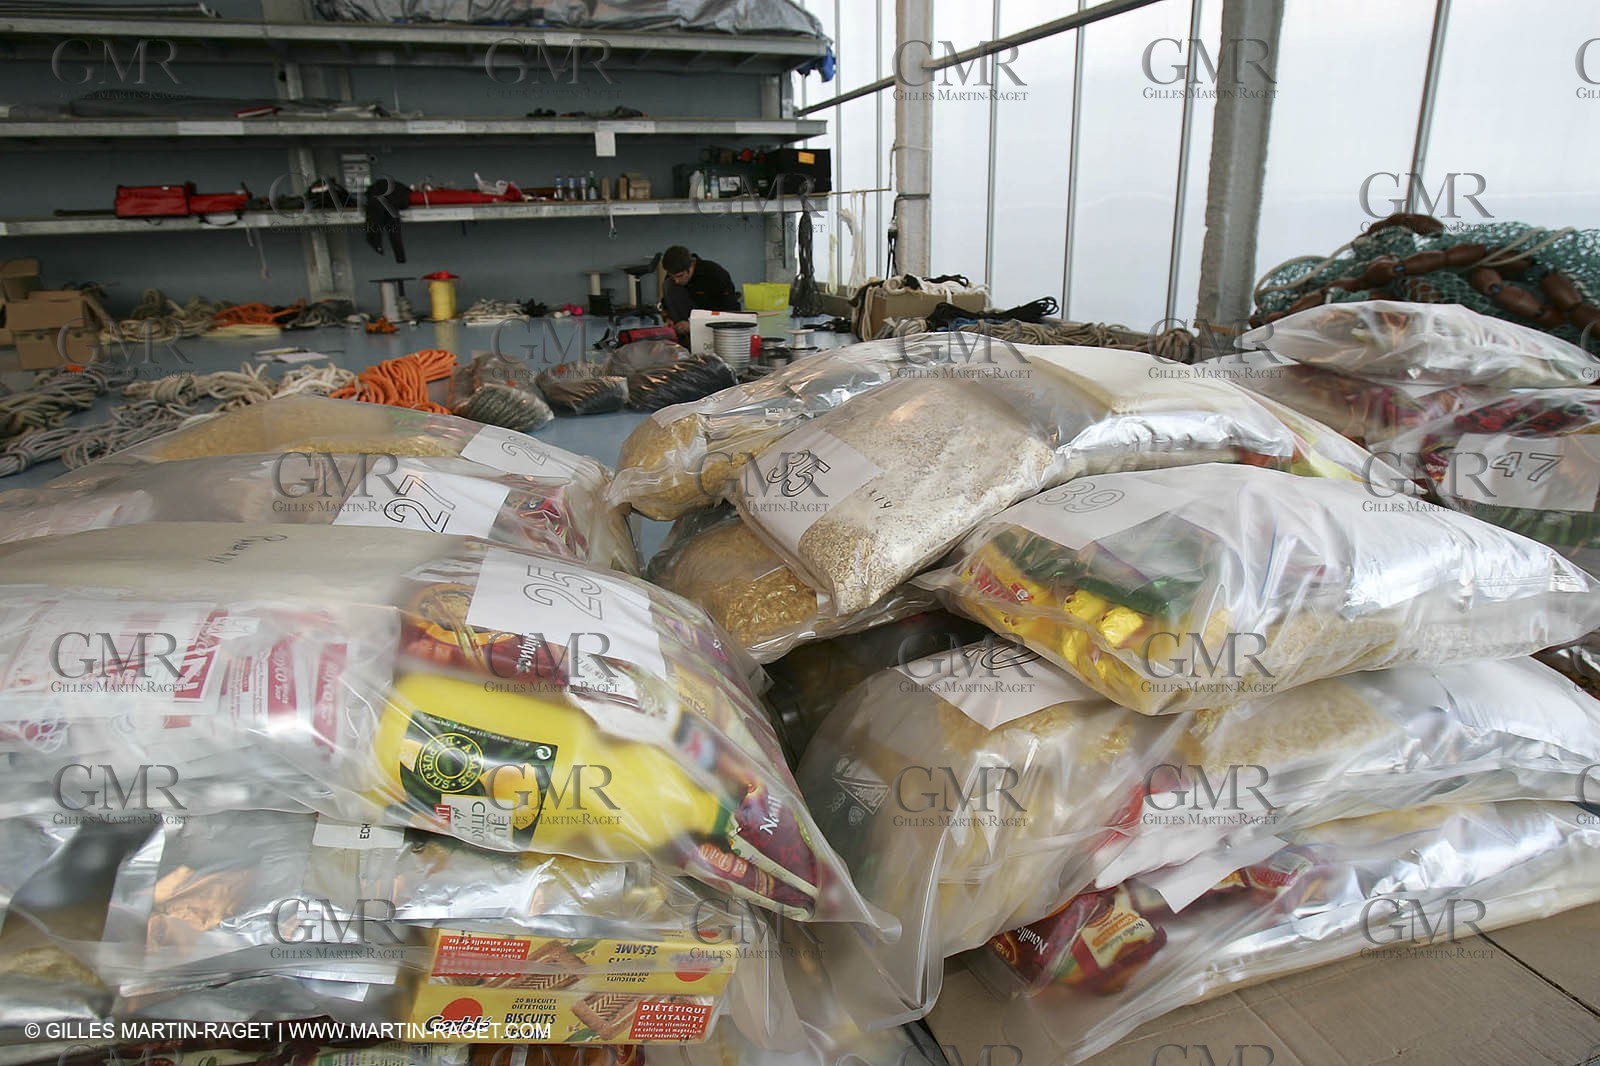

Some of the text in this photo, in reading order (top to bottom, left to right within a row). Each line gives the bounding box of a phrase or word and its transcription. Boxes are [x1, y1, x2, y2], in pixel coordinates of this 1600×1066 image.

[1490, 452, 1562, 482] 47
[384, 474, 456, 533] 27
[1036, 481, 1125, 513] 39
[523, 564, 602, 620] 25
[614, 944, 658, 958] SÉSAME
[504, 1012, 557, 1024] BISCUITS
[642, 1003, 708, 1014] DIÉTÉTIQUE
[655, 1014, 704, 1023] VITALITÉ
